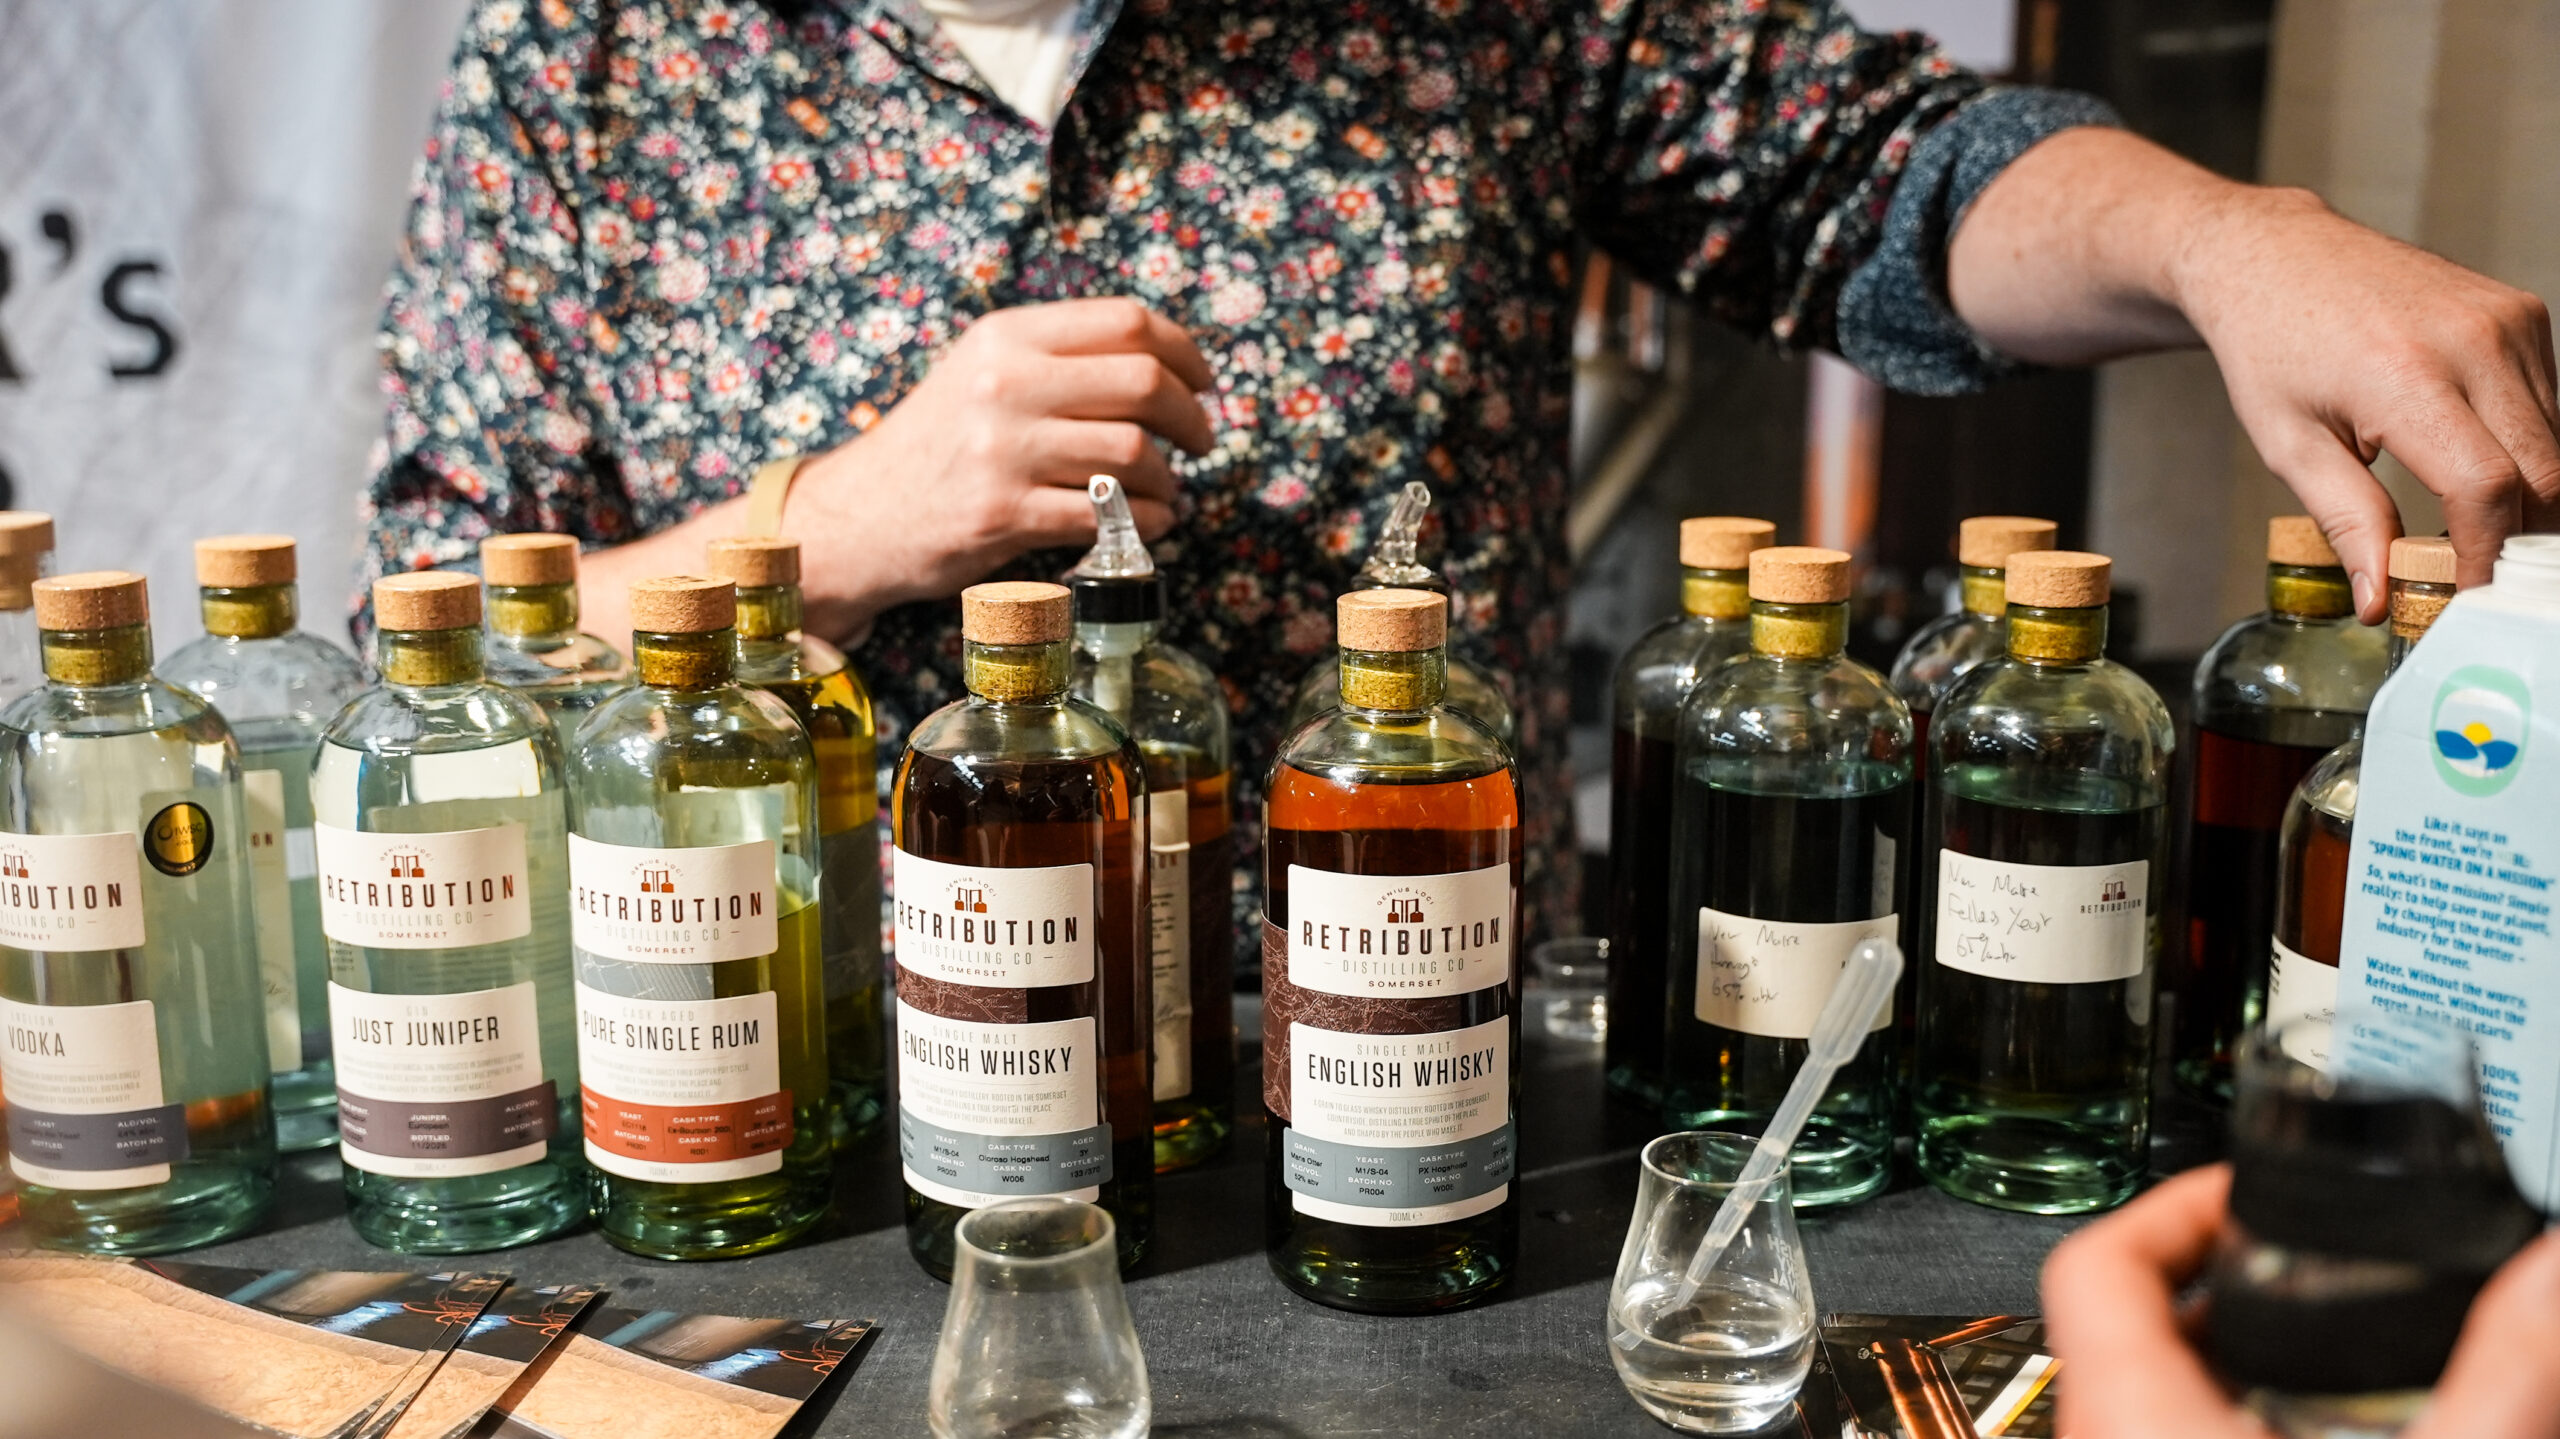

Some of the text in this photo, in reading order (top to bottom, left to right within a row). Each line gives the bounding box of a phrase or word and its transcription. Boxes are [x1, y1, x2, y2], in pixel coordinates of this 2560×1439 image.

[2424, 816, 2448, 832] Like
[2451, 821, 2461, 835] it
[2465, 827, 2489, 841] says
[2395, 829, 2416, 844] the
[2420, 832, 2455, 854] front,
[2420, 851, 2461, 871] WATER
[2465, 861, 2482, 875] ON
[2486, 866, 2493, 878] A
[327, 874, 515, 908] RETRIBUTION
[2367, 864, 2383, 881] So,
[2388, 870, 2426, 887] what's
[2430, 877, 2449, 892] the
[2452, 885, 2504, 904] mission?
[1377, 887, 1434, 906] GENIUS LOCI
[579, 886, 762, 924] RETRIBUTION
[2080, 899, 2141, 914] RETRIBUTION
[2405, 890, 2418, 904] to
[2421, 893, 2448, 912] help
[2451, 903, 2477, 917] save
[2481, 909, 2501, 922] our
[356, 911, 473, 926] DISTILLING CO
[899, 901, 1077, 946] RETRIBUTION
[2384, 902, 2523, 946] by changing the drinks
[378, 931, 448, 939] SOMERSET
[606, 926, 720, 942] DISTILLING CO
[1303, 916, 1500, 955] RETRIBUTION
[2376, 918, 2514, 962] industry for the better
[627, 945, 695, 954] SOMERSET
[921, 941, 1032, 965] DISTILLING CO
[940, 964, 1007, 977] SOMERSET
[1343, 957, 1464, 975] DISTILLING CO
[1368, 979, 1443, 988] SOMERSET
[2366, 956, 2404, 978] Water.
[2408, 967, 2459, 991] Without
[2462, 982, 2482, 997] the
[2365, 973, 2525, 1026] Refreshment. Without the
[661, 1009, 695, 1021] AGED
[352, 1016, 500, 1046] JUST JUNIPER
[583, 1010, 760, 1051] PURE SINGLE RUM
[933, 1025, 1017, 1046] SINGLE MALT
[8, 1024, 66, 1057] VODKA
[904, 1029, 1072, 1076] ENGLISH WHISKY
[1357, 1041, 1451, 1057] SINGLE MALT
[1308, 1046, 1495, 1088] ENGLISH WHISKY
[2481, 1064, 2520, 1085] 100%
[1024, 1093, 1035, 1101] THE
[1036, 1090, 1068, 1101] SOMERSET
[1335, 1103, 1342, 1112] TO
[1343, 1103, 1362, 1114] GLASS
[1363, 1105, 1388, 1115] WHISKY
[1424, 1104, 1447, 1114] ROOTED
[1455, 1100, 1465, 1109] THE
[1465, 1092, 1490, 1108] SOMERSET
[1033, 1103, 1052, 1113] PLACE
[672, 1116, 697, 1124] CASK
[1009, 1116, 1026, 1126] MAKE
[1368, 1117, 1402, 1127] DISTILLING
[1408, 1118, 1423, 1127] TRUE
[1424, 1115, 1443, 1126] SPIRIT
[1444, 1115, 1451, 1124] OF
[1452, 1113, 1462, 1122] THE
[1462, 1108, 1479, 1120] PLACE
[1343, 1125, 1456, 1138] AND SHAPED BY THE PEOPLE WHO MAKE
[678, 1136, 702, 1144] CASK
[987, 1143, 1012, 1151] CASK
[1072, 1136, 1095, 1146] AGED
[930, 1153, 952, 1165] BATCH
[978, 1154, 1050, 1164] Oloroso Hogshead
[1060, 1158, 1093, 1169] BOTTLE
[1290, 1151, 1323, 1167] Maris Otter
[1356, 1155, 1386, 1165] YEAST.
[1419, 1155, 1442, 1163] CASK
[1355, 1166, 1389, 1176] M1/S-04
[1418, 1161, 1468, 1175] PX Hogshead
[1001, 1175, 1025, 1183] W006
[1294, 1173, 1319, 1187] 52% abv
[1347, 1176, 1395, 1187] BATCH NO.
[1424, 1176, 1447, 1184] CASK
[1359, 1187, 1385, 1196] PR004
